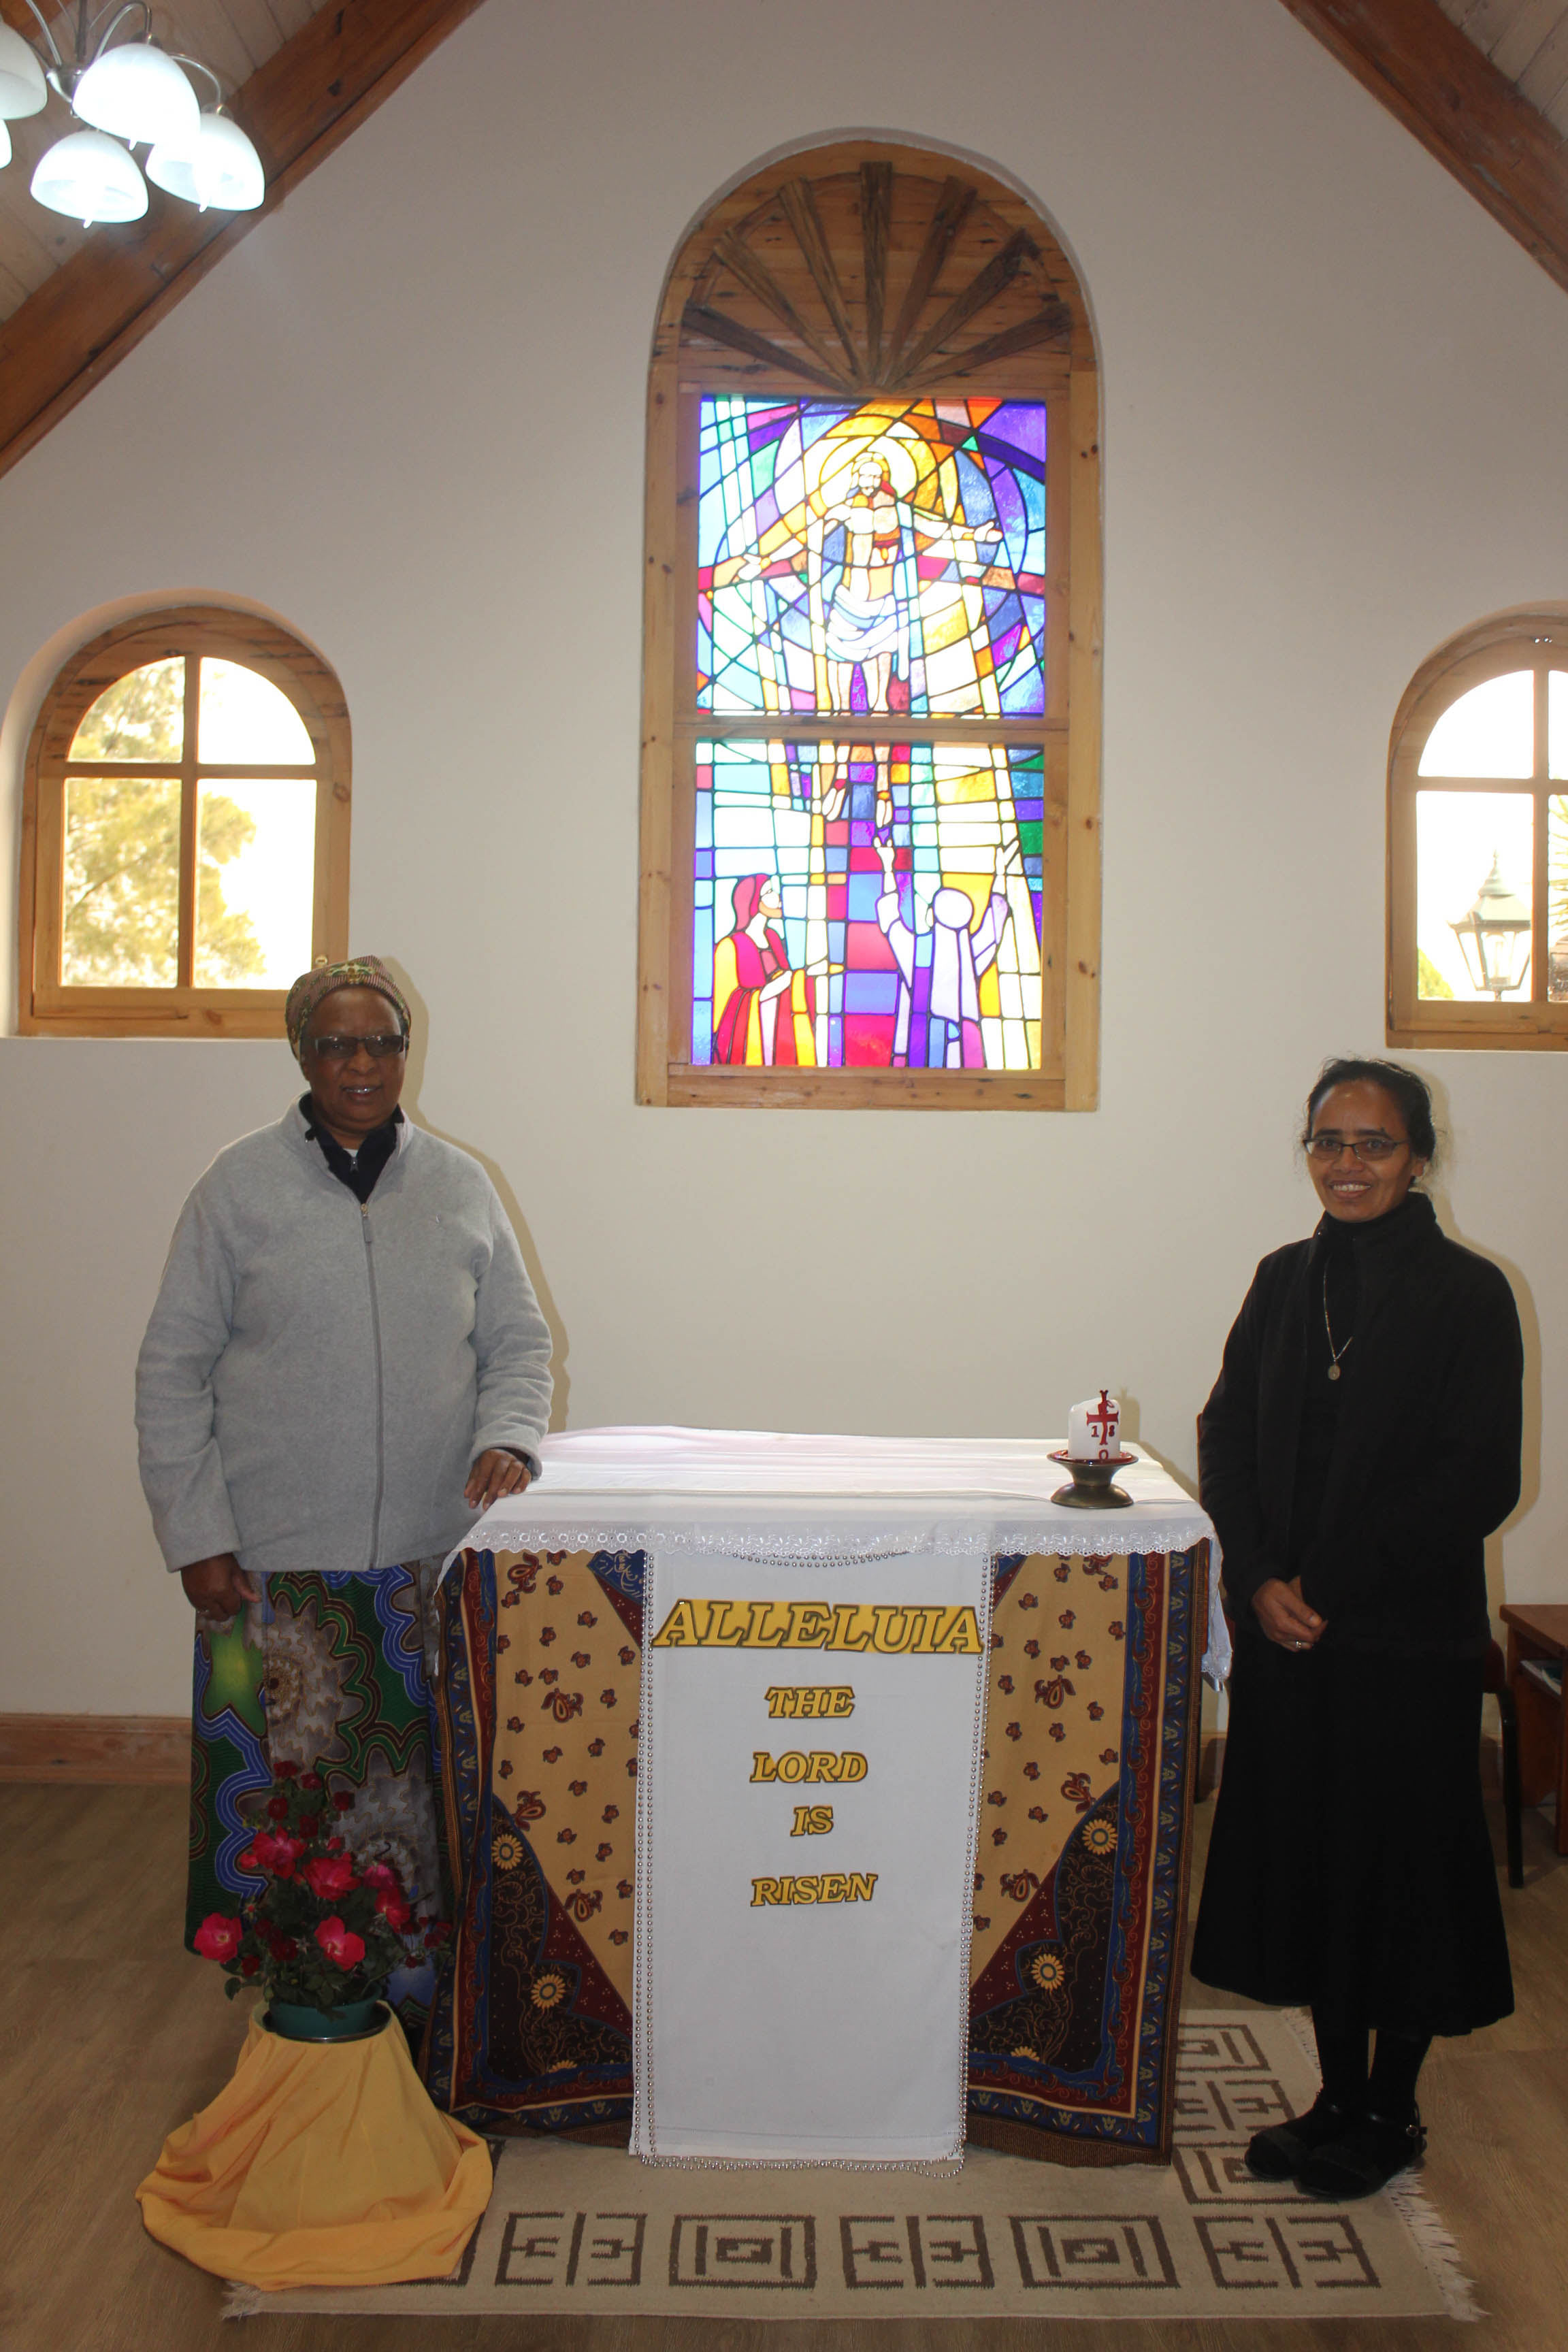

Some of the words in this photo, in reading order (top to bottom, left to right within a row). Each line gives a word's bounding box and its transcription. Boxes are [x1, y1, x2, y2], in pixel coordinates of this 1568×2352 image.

[1091, 1425, 1099, 1437] 1
[651, 1599, 985, 1654] ALLELUIA
[764, 1686, 855, 1718] THE
[749, 1751, 868, 1783] LORD
[790, 1805, 834, 1837] IS
[751, 1873, 878, 1907] RISEN
